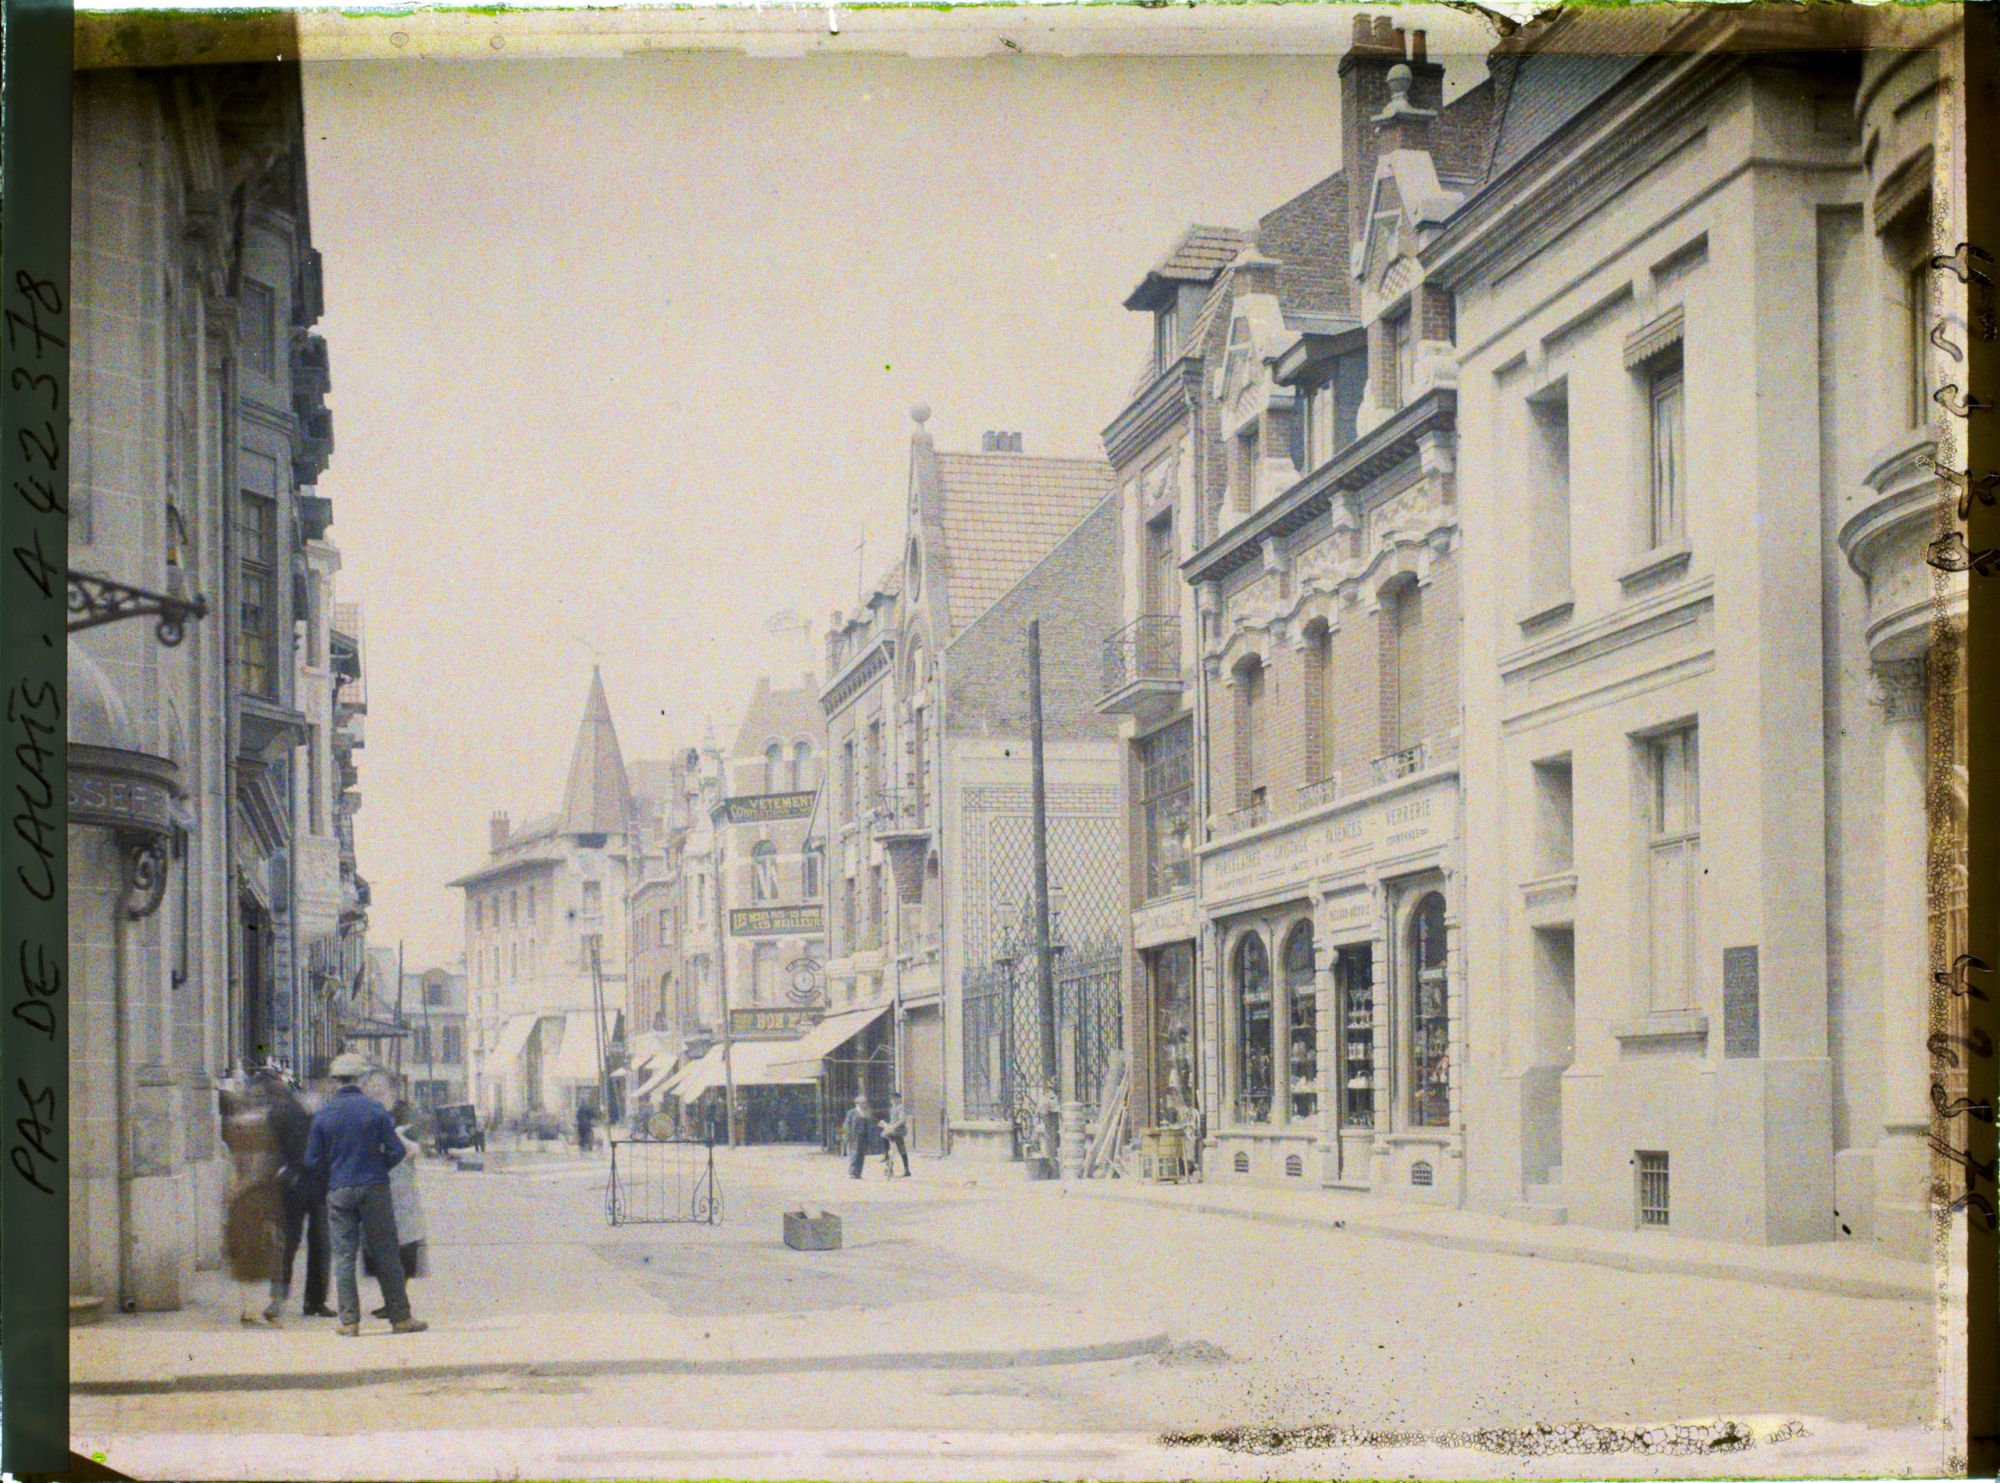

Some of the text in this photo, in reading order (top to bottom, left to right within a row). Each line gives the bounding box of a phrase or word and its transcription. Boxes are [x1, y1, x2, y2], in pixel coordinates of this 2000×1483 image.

[5, 269, 67, 516] 42378
[1385, 798, 1431, 827] VERRERIE
[11, 939, 62, 1041] DE
[10, 1078, 59, 1195] PAS
